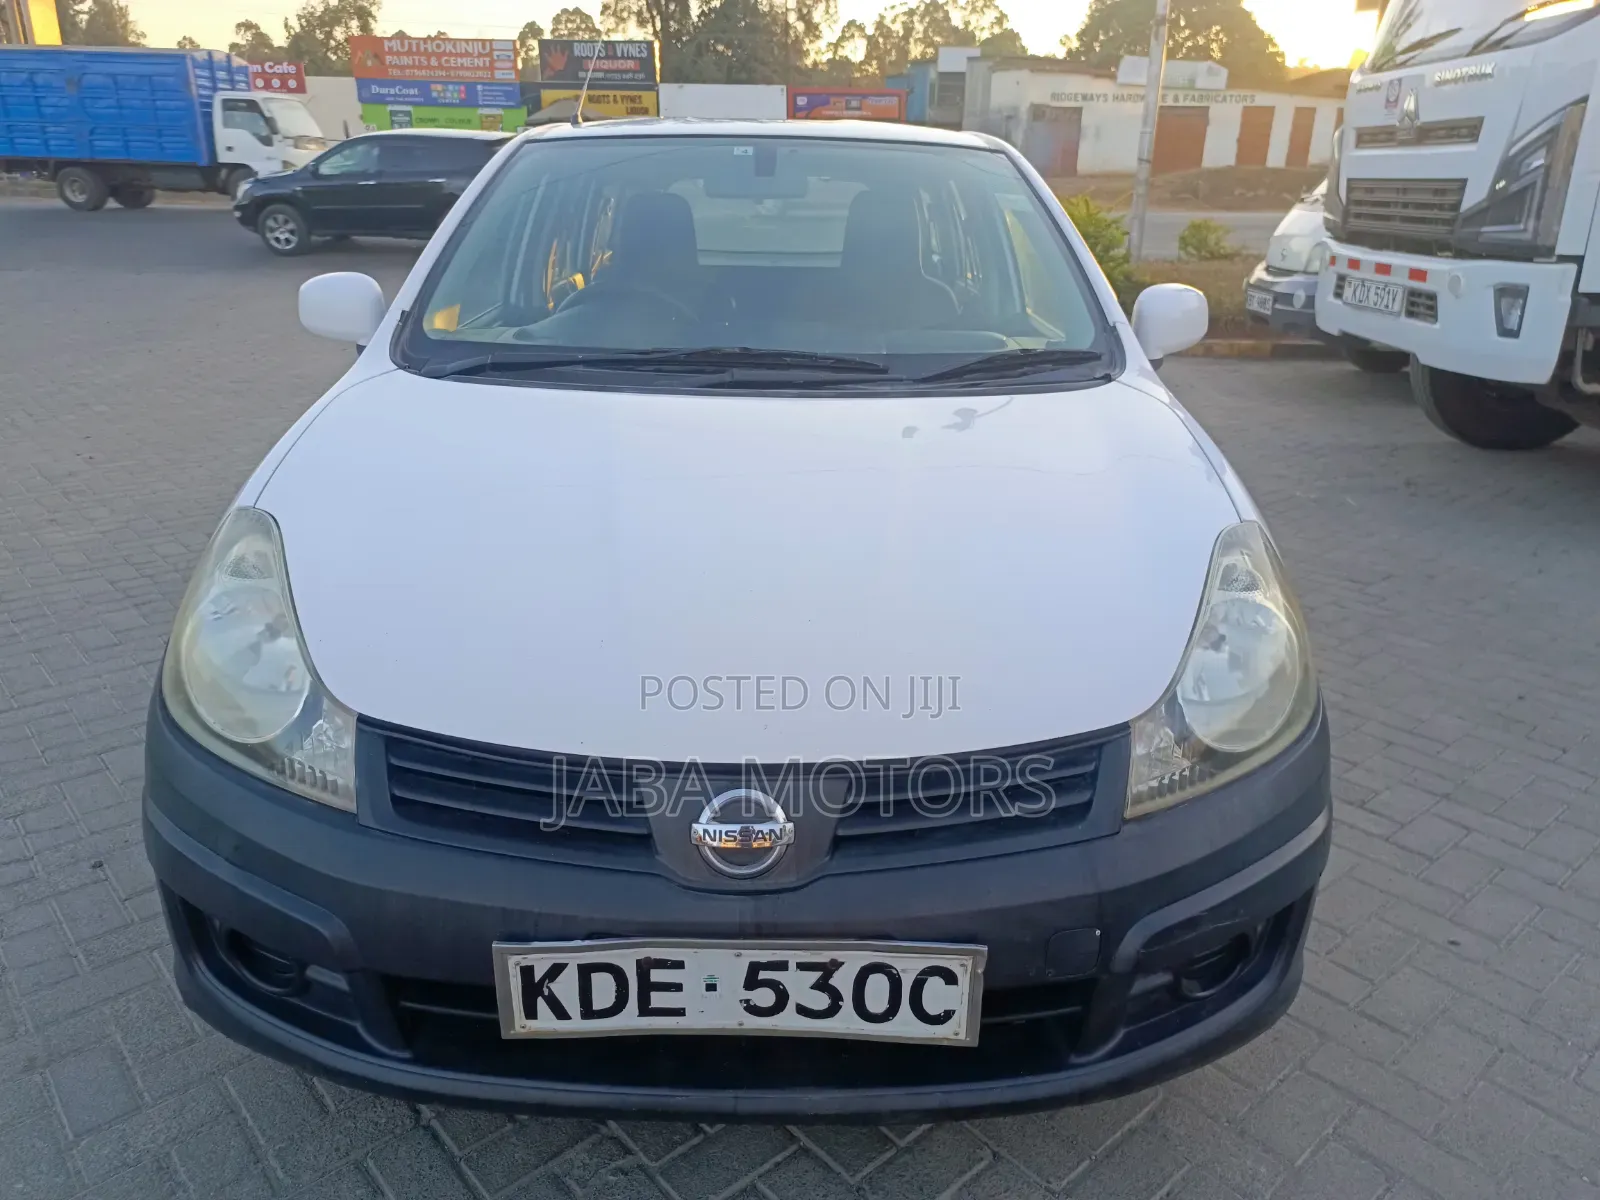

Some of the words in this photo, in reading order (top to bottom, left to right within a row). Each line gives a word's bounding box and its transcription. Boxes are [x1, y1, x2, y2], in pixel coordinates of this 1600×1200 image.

[383, 40, 491, 56] MUTHOKINJU
[573, 42, 606, 58] ROOTS
[616, 42, 648, 58] VYNES
[264, 61, 297, 74] Cafe
[385, 55, 428, 66] PAINTS
[430, 57, 439, 67] &
[442, 57, 490, 67] CEMENT
[371, 84, 419, 96] DuraCoat
[1050, 91, 1108, 103] RIDGEWAYS
[1173, 93, 1180, 103] &
[1183, 94, 1256, 105] FABRICATORS
[1351, 279, 1371, 305] KDX
[1373, 284, 1399, 312] 591Y
[702, 827, 783, 843] NISSAN
[518, 957, 687, 1022] KDE
[738, 958, 960, 1026] 530C
